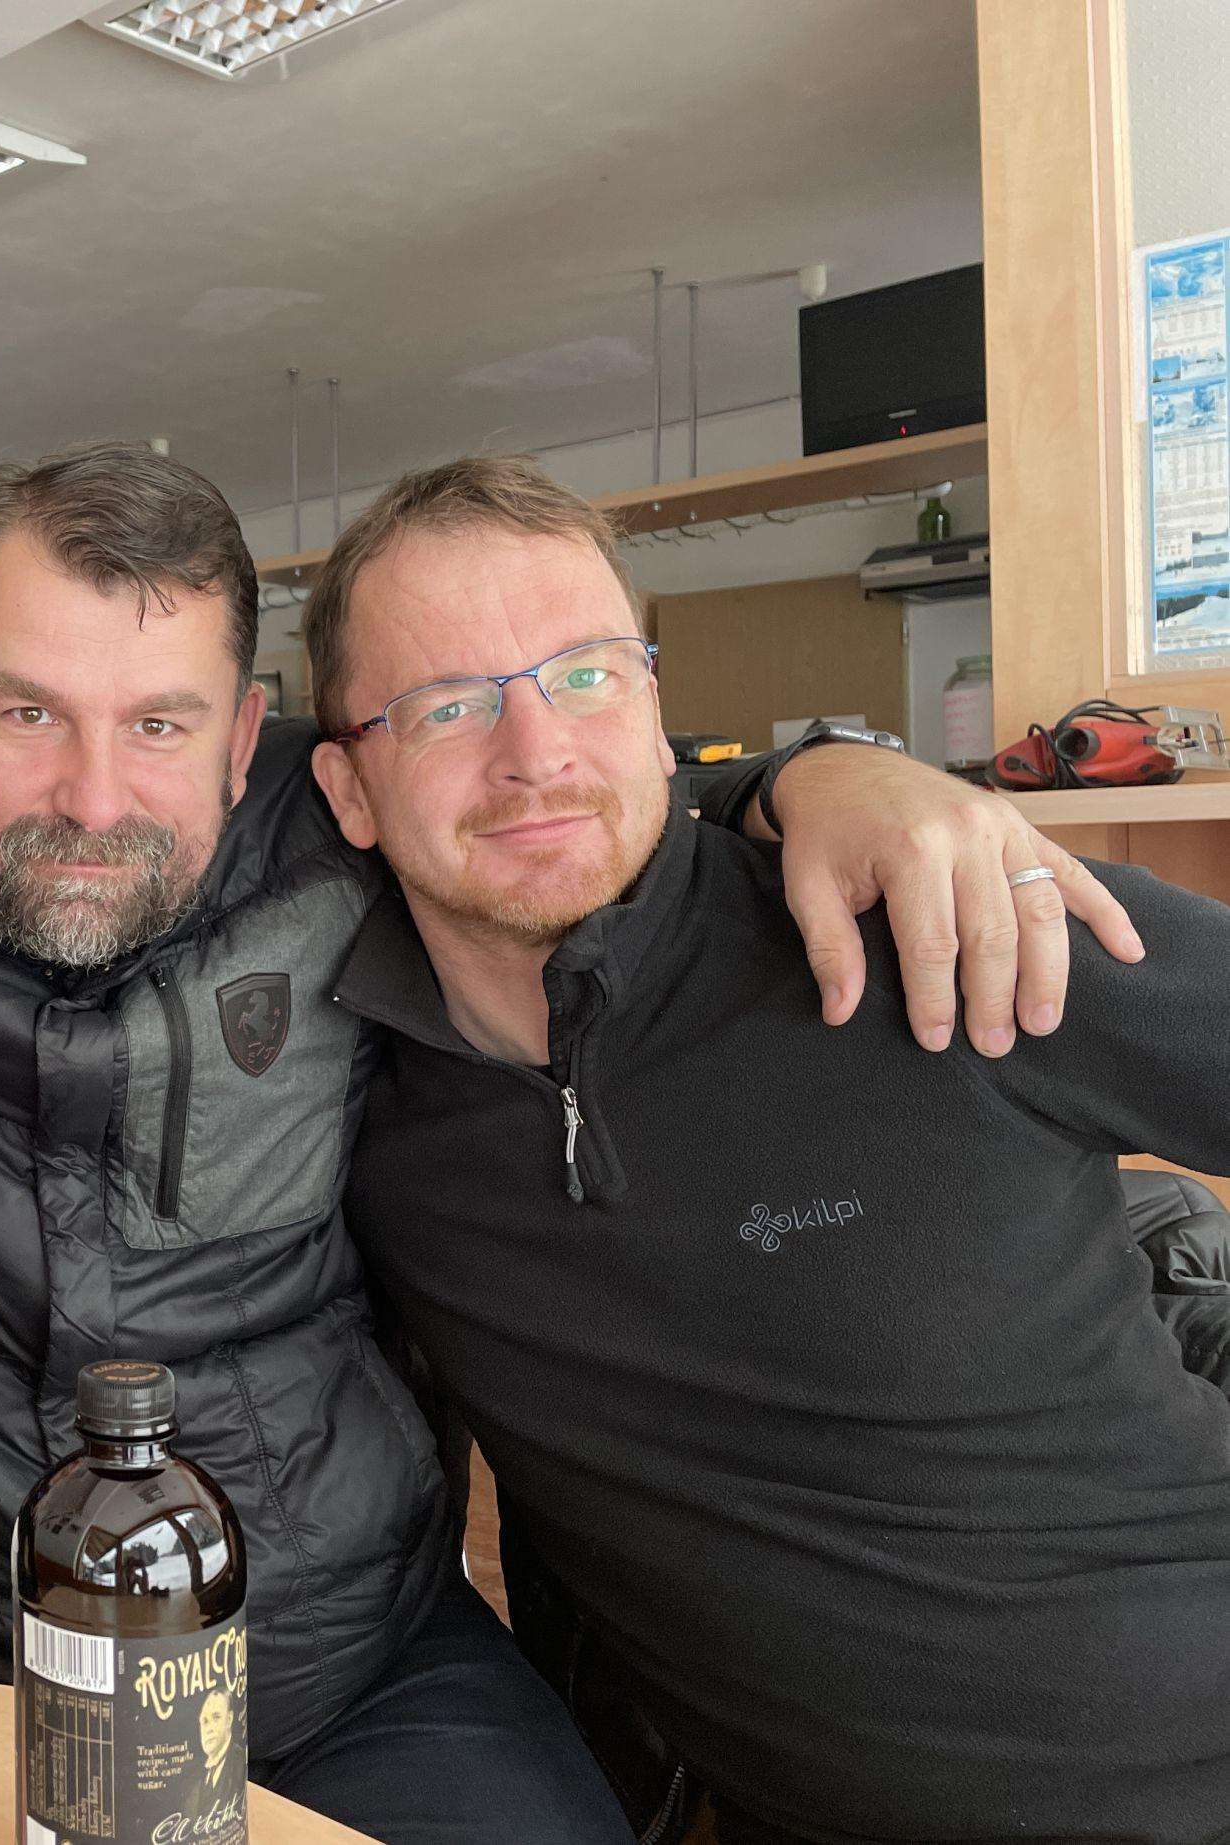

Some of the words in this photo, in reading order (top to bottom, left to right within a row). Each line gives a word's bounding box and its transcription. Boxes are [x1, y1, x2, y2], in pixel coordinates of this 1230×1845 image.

[792, 1188, 864, 1230] kilpi
[135, 1656, 217, 1721] ROYAL
[136, 1740, 188, 1757] Traditional
